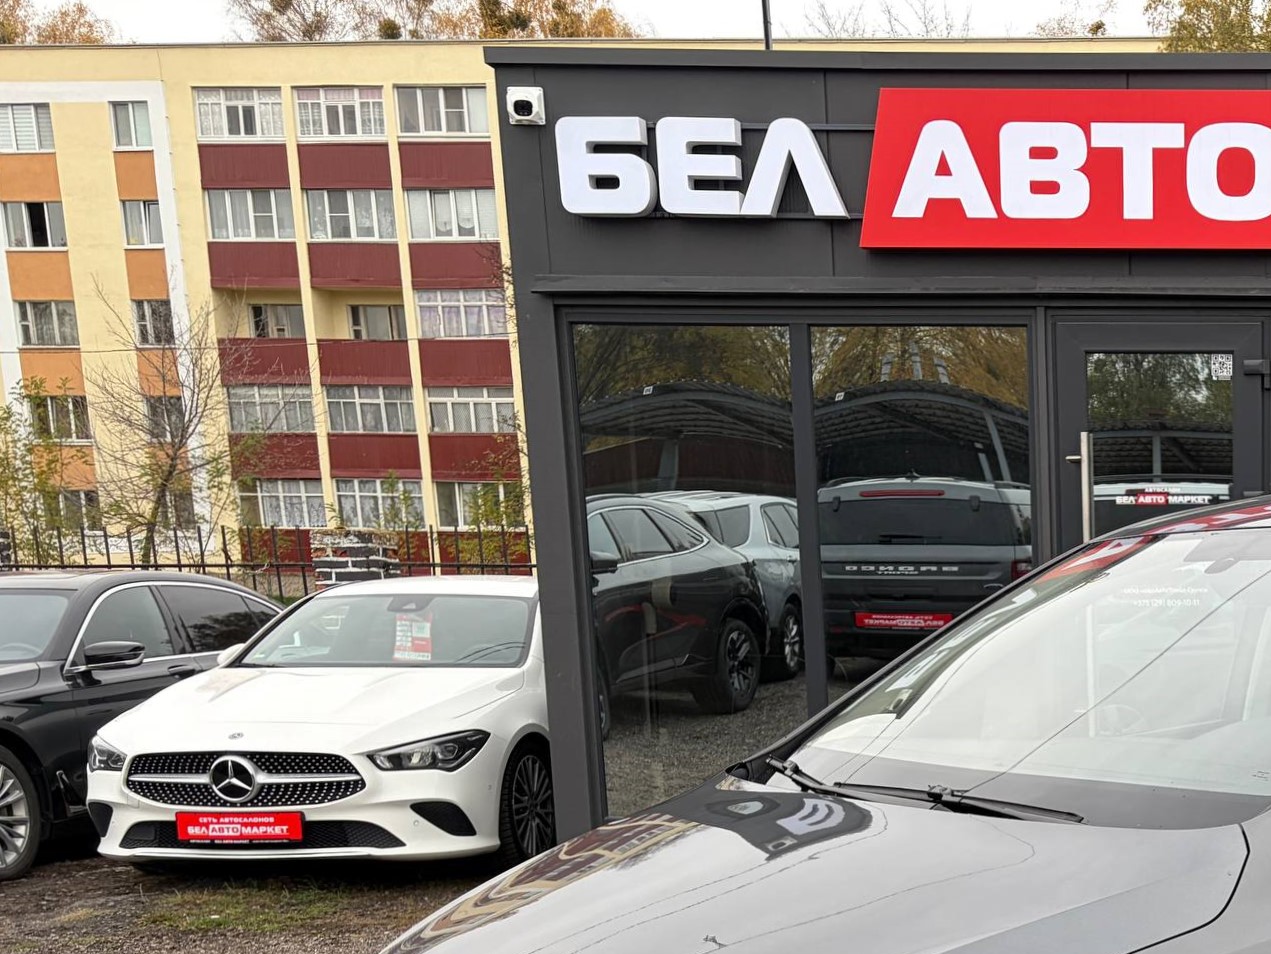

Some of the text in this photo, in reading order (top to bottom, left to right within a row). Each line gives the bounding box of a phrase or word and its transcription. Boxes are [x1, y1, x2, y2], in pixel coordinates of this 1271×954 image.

[555, 116, 850, 219] БЕЛ
[1115, 495, 1211, 505] БЕЛ АВТО МАРКЕТ
